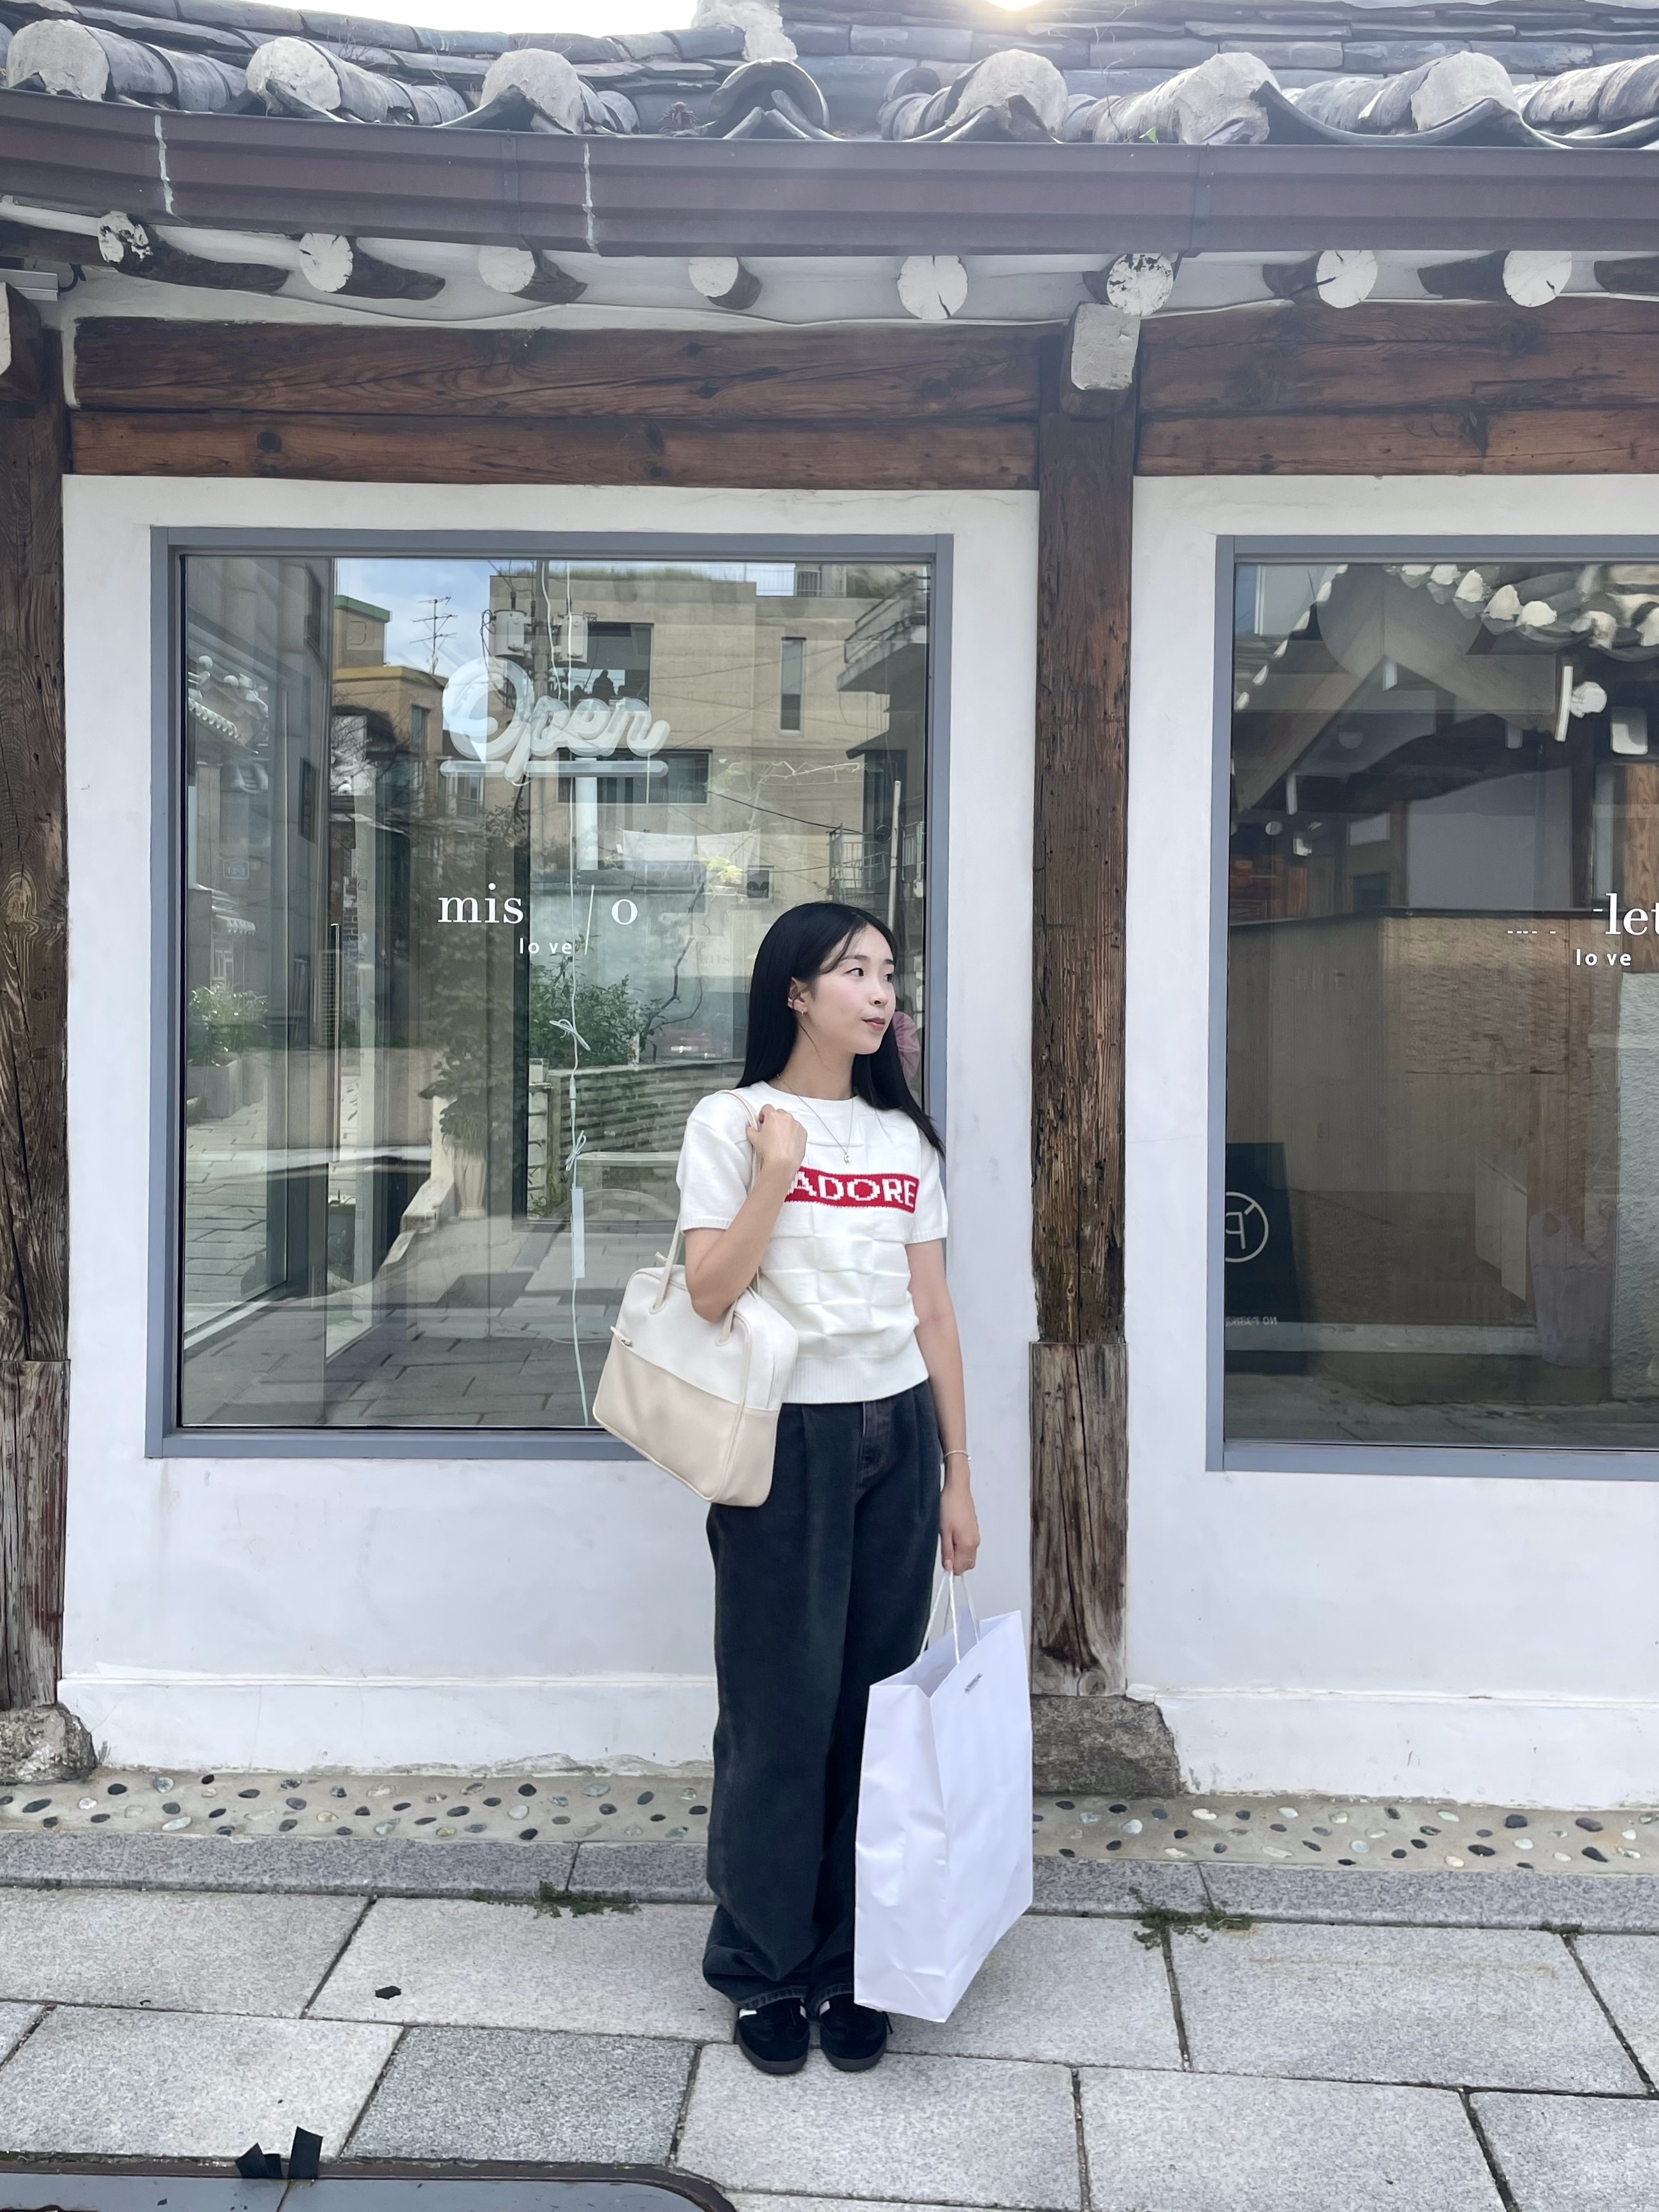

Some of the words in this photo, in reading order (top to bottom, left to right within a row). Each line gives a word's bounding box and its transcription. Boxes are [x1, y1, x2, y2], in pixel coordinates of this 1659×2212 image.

[442, 656, 671, 782] Open
[438, 882, 523, 924] mis
[611, 899, 638, 924] o
[787, 1170, 916, 1208] ADORE
